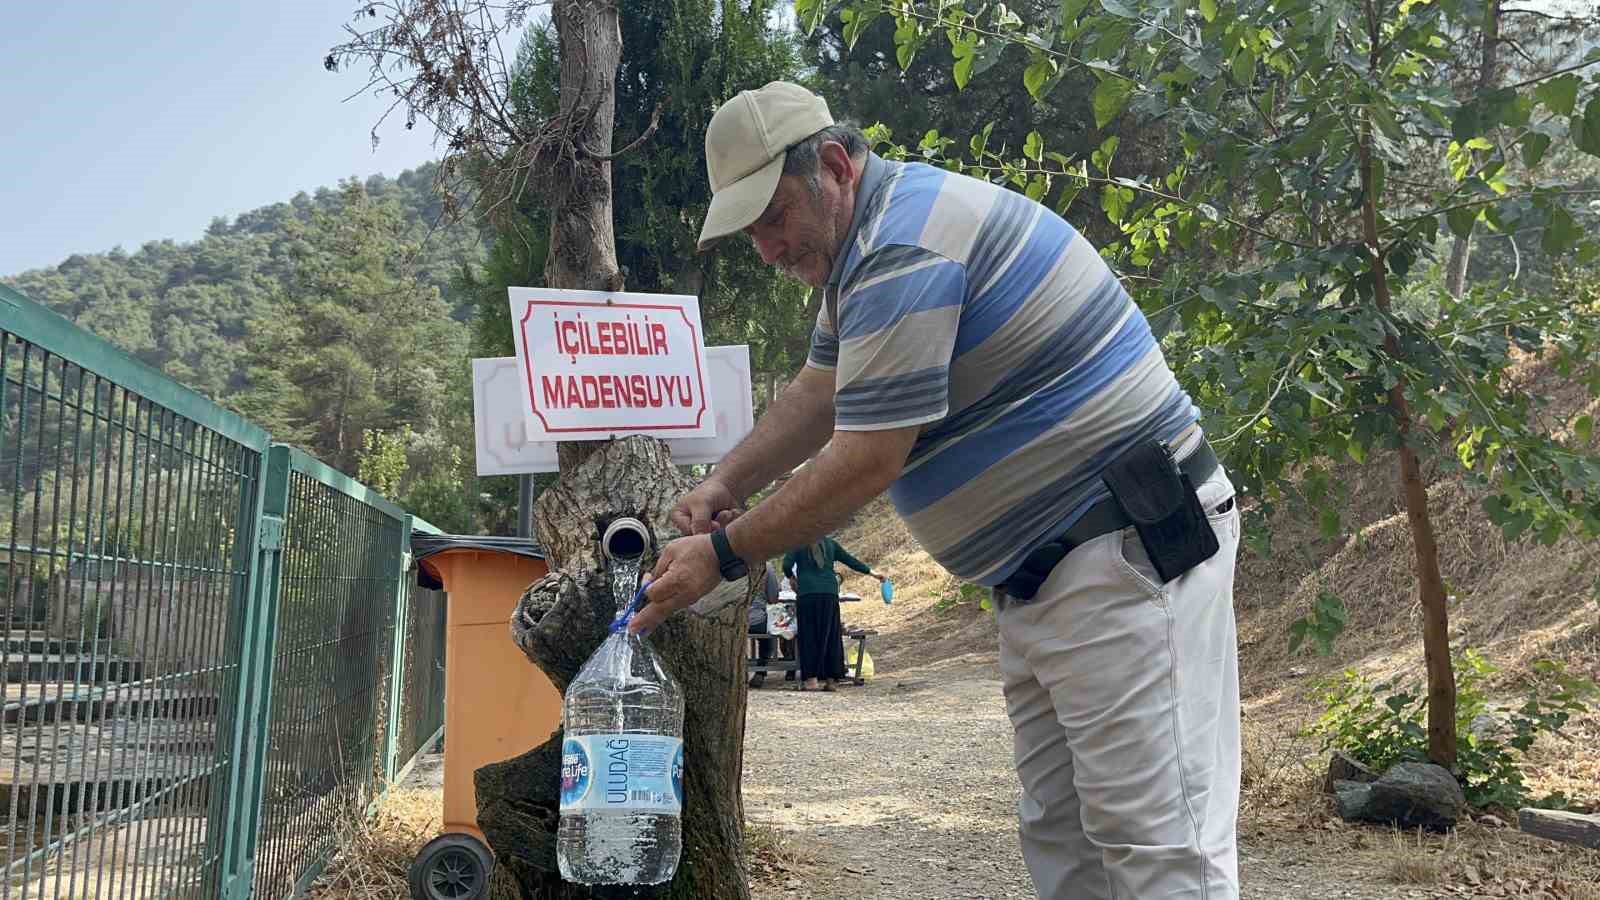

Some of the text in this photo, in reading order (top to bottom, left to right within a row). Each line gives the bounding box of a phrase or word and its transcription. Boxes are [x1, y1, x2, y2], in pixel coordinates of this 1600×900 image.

[553, 312, 669, 364] İÇİLEBİLİR
[541, 374, 693, 409] MADENSUYU
[606, 738, 629, 804] ULUDAĞ
